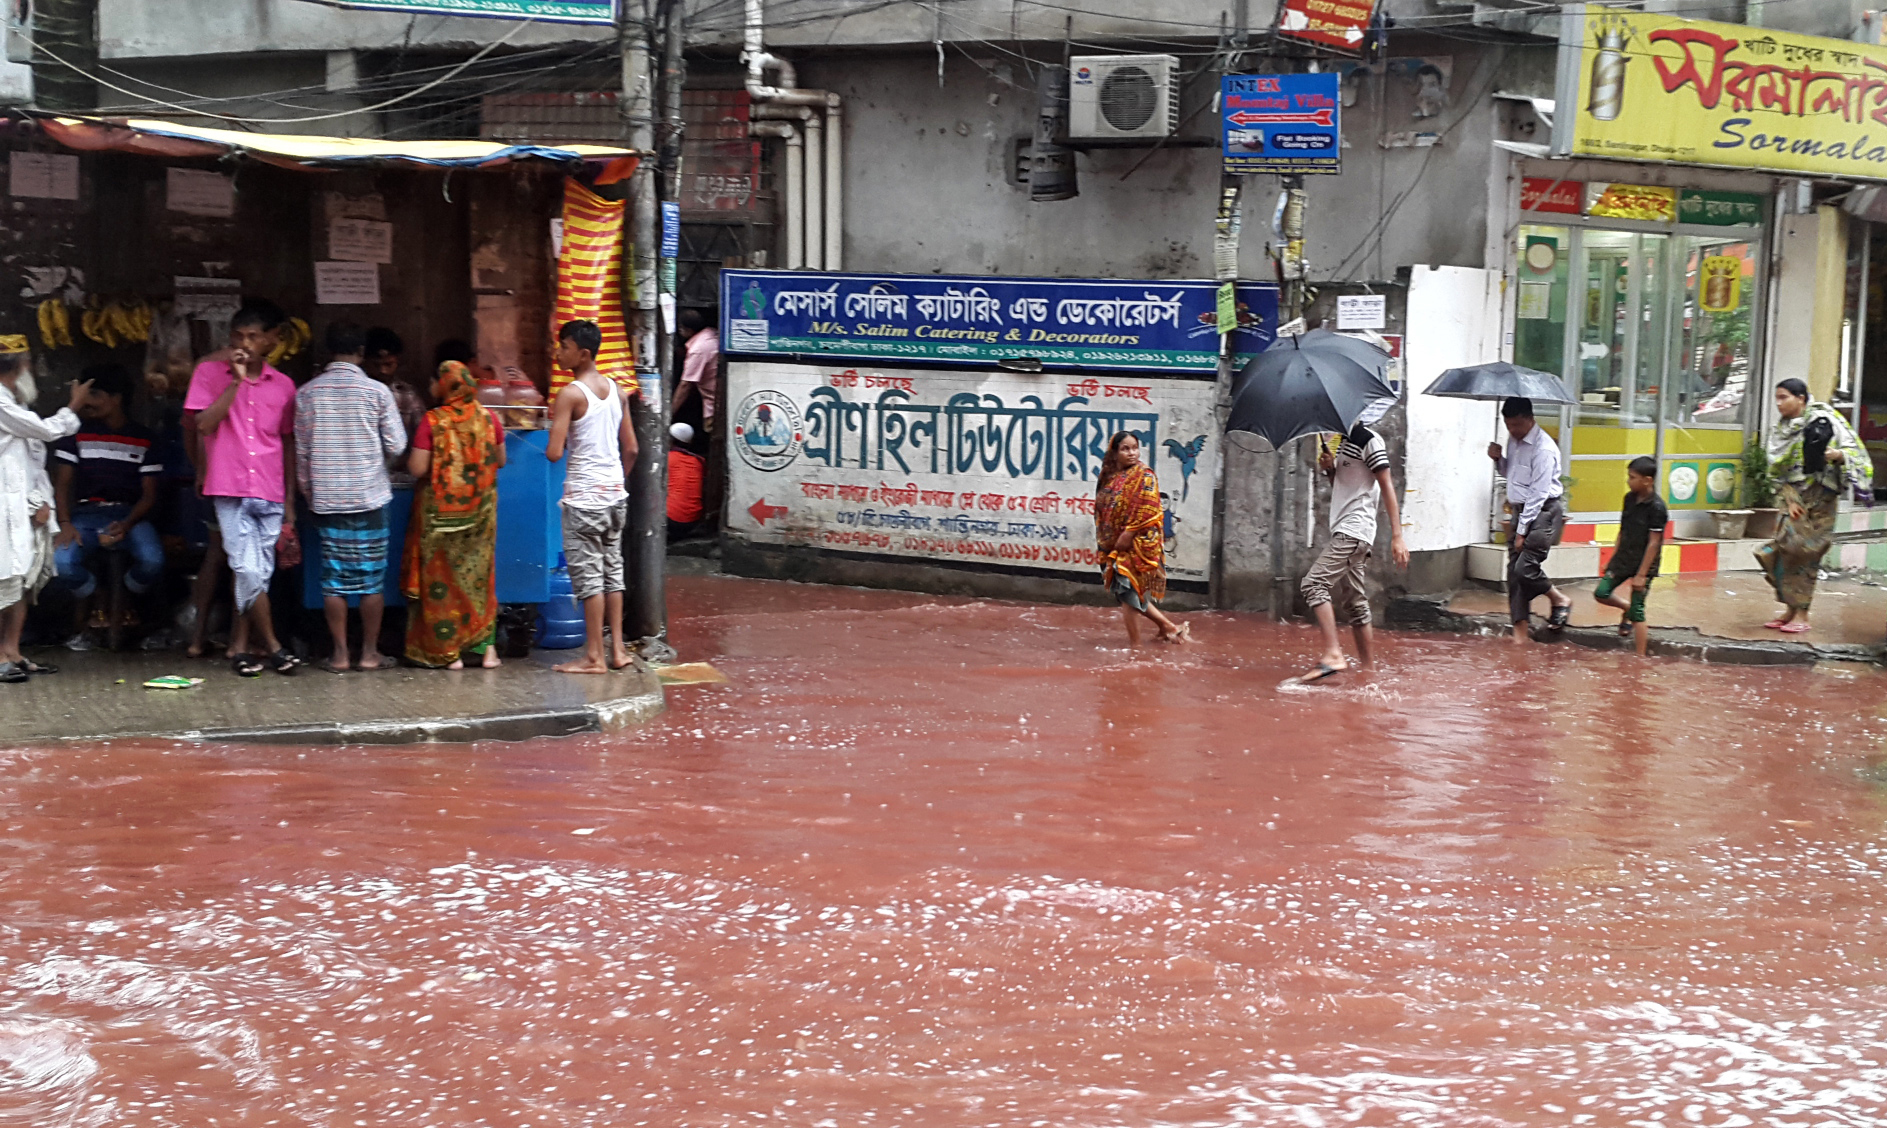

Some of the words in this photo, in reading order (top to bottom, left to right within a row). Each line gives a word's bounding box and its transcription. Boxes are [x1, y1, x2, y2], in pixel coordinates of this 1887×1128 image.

[1227, 79, 1281, 93] INTEX
[774, 282, 842, 318] মেসার্স
[844, 286, 910, 321] সেলিম
[913, 286, 1003, 326] ক্যাটারিং
[1008, 297, 1049, 325] এন্ড
[1057, 290, 1186, 329] ডেকোরেটর্স
[808, 321, 848, 336] M/s.
[853, 323, 909, 338] Salim
[914, 325, 999, 344] Catering
[1004, 328, 1022, 341] &
[1026, 329, 1140, 345] Decorators
[830, 369, 859, 388] ভর্তি
[864, 375, 918, 395] চলছে
[1067, 378, 1100, 397] ভর্তি
[1103, 386, 1152, 405] চলছে
[873, 388, 940, 475] হিল
